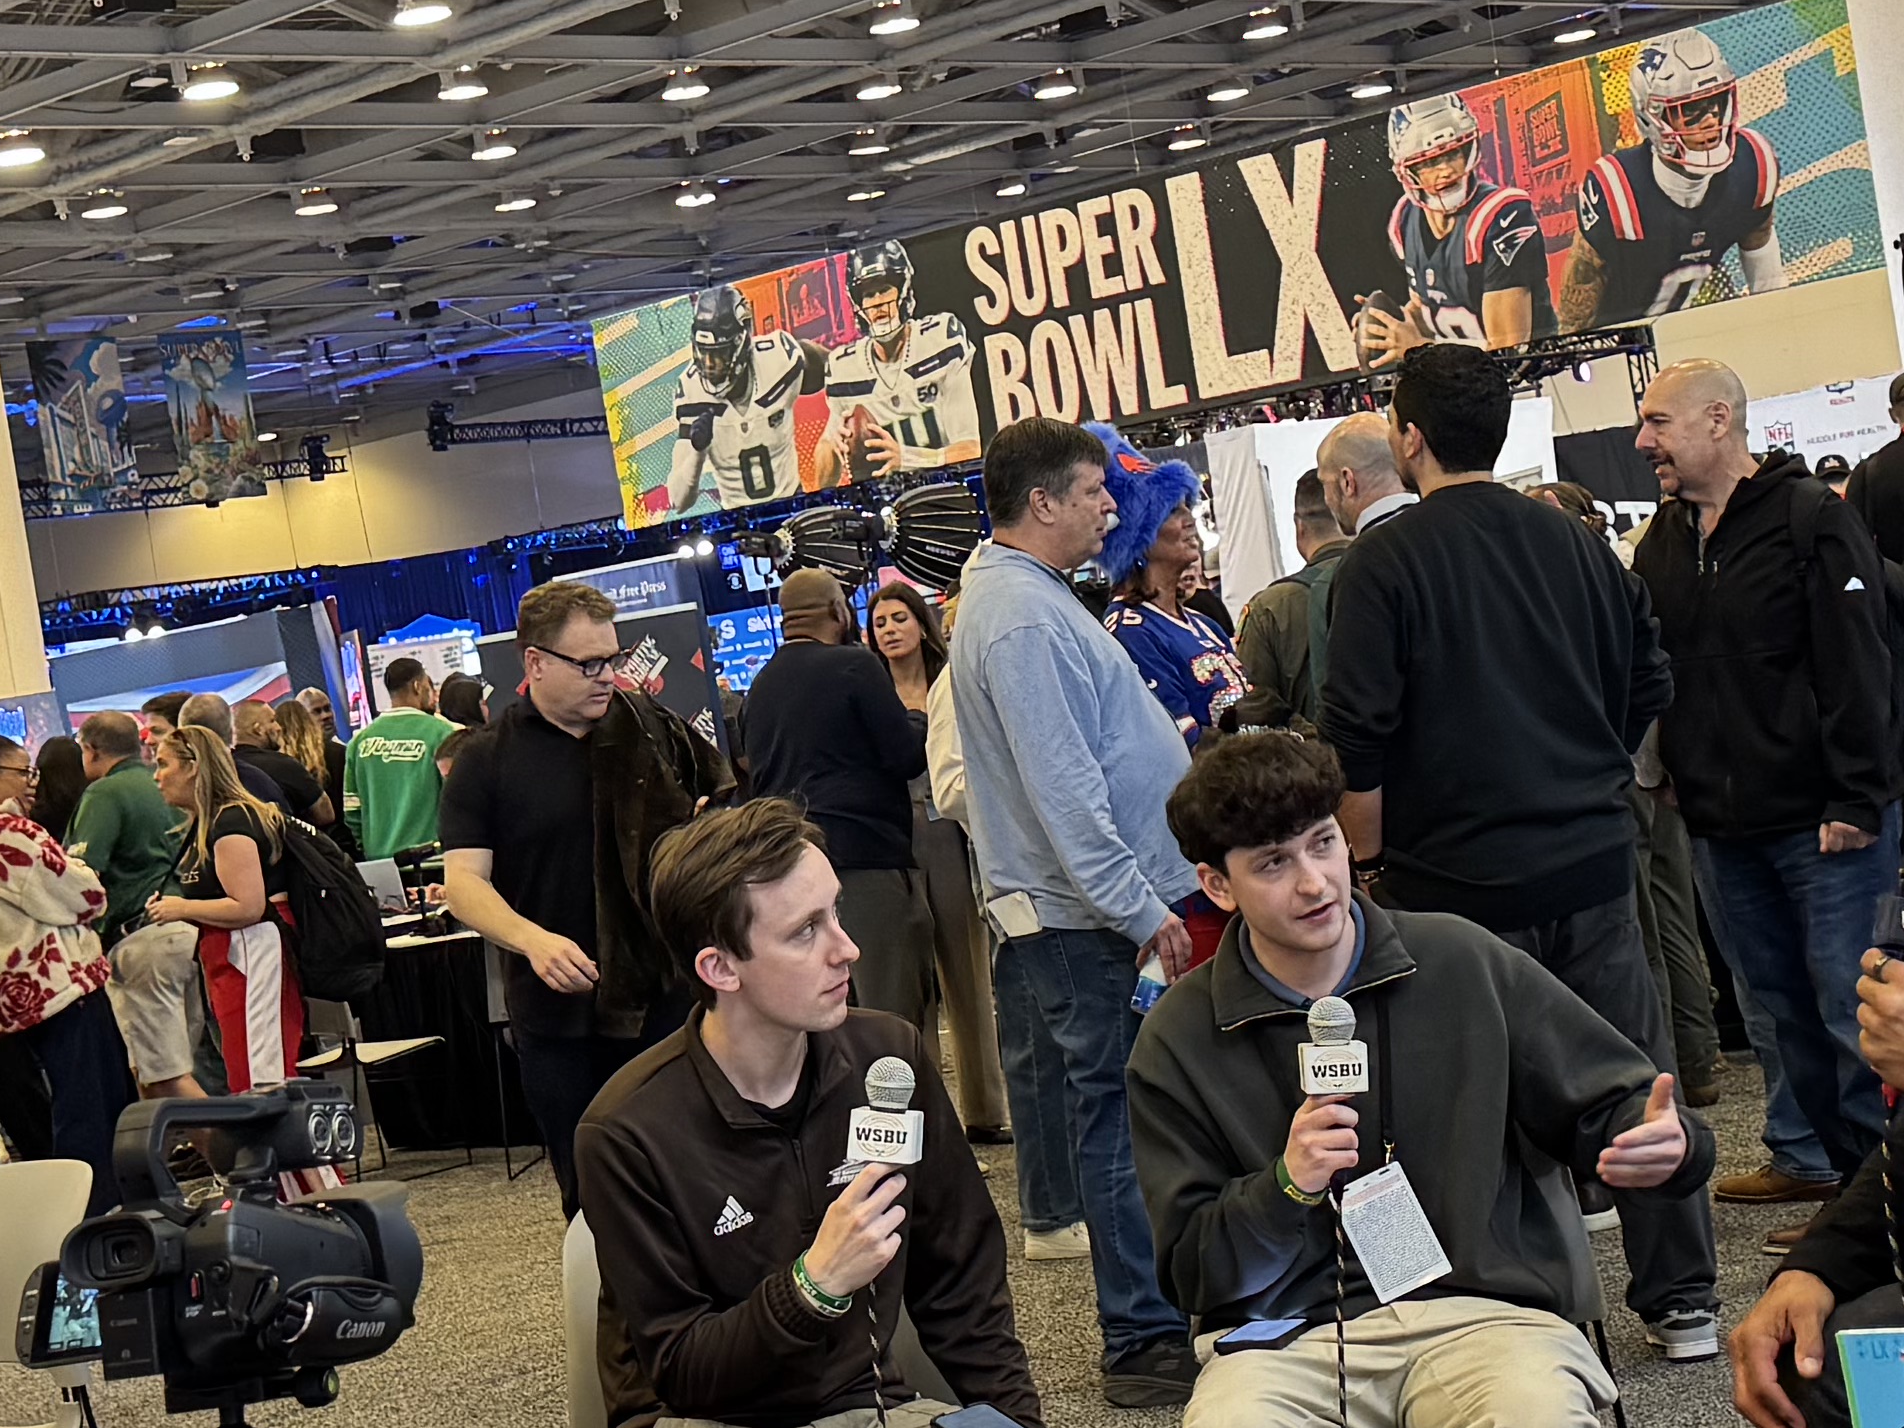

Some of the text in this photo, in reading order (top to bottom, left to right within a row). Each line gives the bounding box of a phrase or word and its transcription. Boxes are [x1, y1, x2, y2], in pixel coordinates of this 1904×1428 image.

[965, 188, 1166, 325] SUPER
[1165, 138, 1361, 399] LX
[984, 298, 1189, 434] BOWL
[1311, 1062, 1362, 1079] WSBU
[855, 1126, 908, 1145] WSBU
[713, 1210, 754, 1236] adidas
[336, 1317, 386, 1341] Canon
